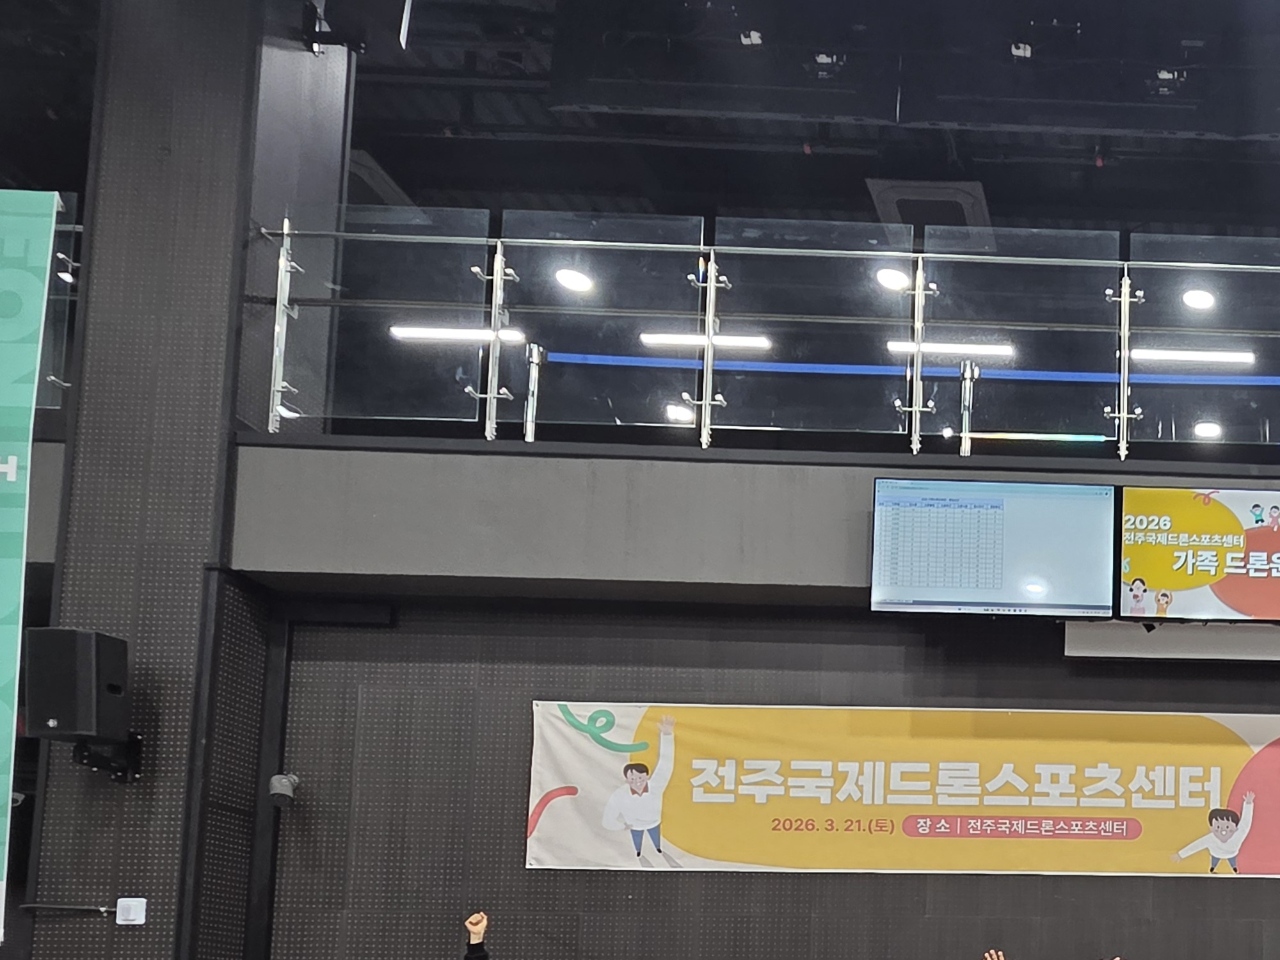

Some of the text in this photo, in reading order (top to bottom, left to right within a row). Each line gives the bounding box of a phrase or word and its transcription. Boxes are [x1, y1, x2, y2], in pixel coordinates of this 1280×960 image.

[1124, 514, 1171, 530] 2026
[1124, 532, 1244, 548] 전주국제드론스포츠센터
[1172, 549, 1219, 576] 가족
[690, 758, 1223, 811] 전주국제드론스포츠센터
[771, 817, 821, 832] 2026.
[825, 818, 841, 833] 3.
[967, 819, 1128, 837] 전주국제드론스포츠센터
